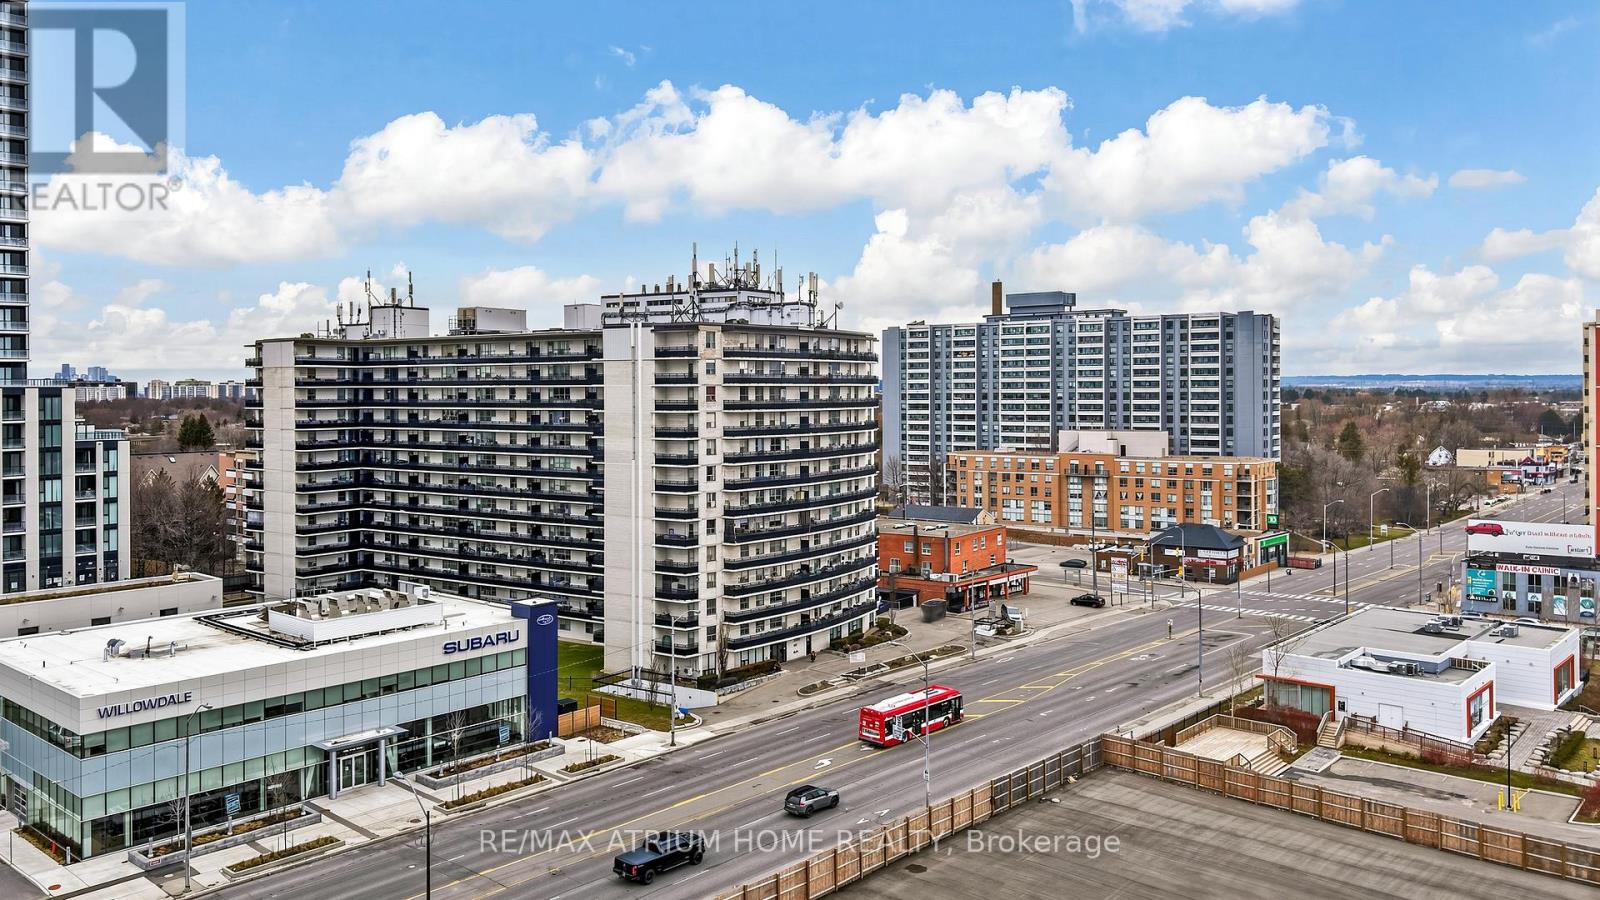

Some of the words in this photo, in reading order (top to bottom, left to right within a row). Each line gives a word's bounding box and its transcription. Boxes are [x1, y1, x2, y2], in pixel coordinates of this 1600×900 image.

[1496, 564, 1530, 573] WALK-IN
[1532, 567, 1560, 575] CLINIC
[443, 629, 520, 655] SUBARU
[97, 691, 192, 719] WILLOWDALE
